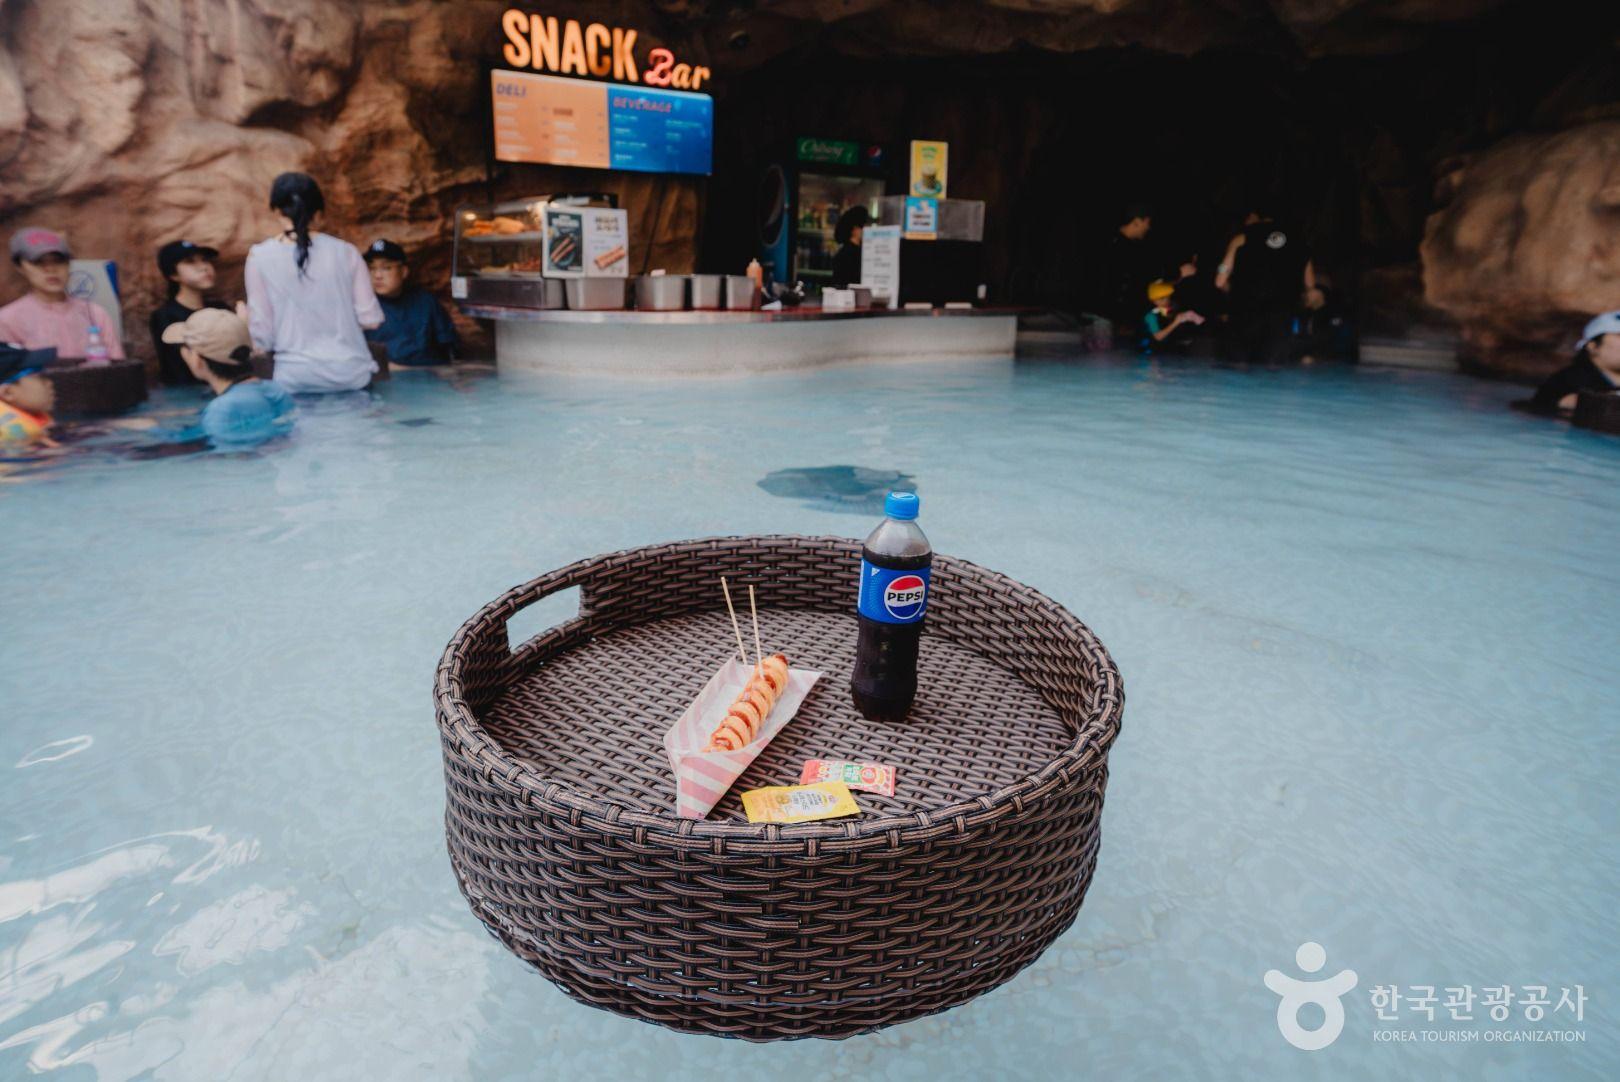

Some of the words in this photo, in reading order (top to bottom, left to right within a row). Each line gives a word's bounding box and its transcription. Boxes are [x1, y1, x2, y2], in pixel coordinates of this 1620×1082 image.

[502, 9, 639, 83] SNACK
[643, 47, 711, 90] Bar
[496, 82, 527, 98] DELI
[613, 96, 673, 113] BEVERAGE
[887, 591, 924, 602] PEPSI
